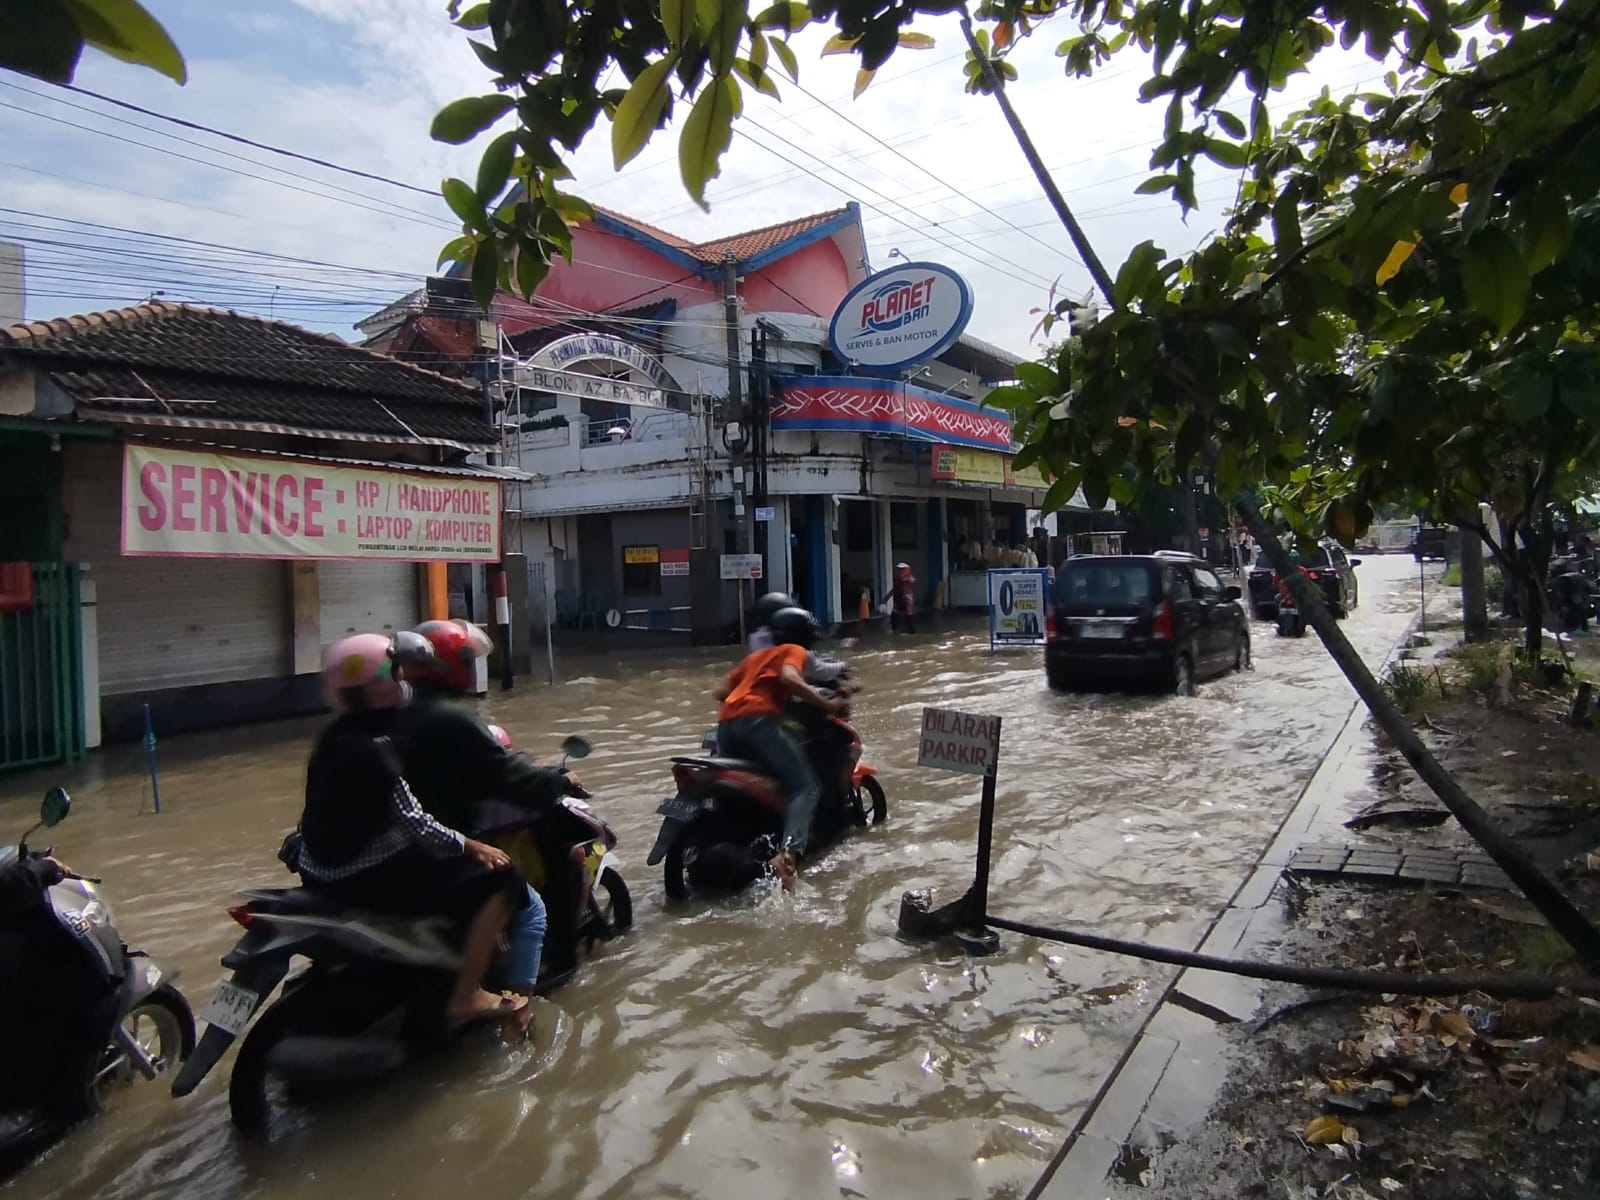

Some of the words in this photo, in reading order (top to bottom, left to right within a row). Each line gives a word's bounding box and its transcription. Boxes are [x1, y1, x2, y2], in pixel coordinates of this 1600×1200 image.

[861, 276, 936, 329] PLANET
[903, 304, 930, 326] BAN
[846, 340, 874, 351] SERVIS
[884, 335, 902, 345] BAN
[904, 329, 938, 341] MOTOR
[533, 371, 573, 391] BLOK
[138, 461, 324, 537] SERVICE
[356, 480, 380, 508] HP
[397, 483, 491, 516] HANDPHONE
[357, 515, 413, 540] LAPTOP
[425, 519, 492, 543] KOMPUTER
[922, 738, 987, 766] PARKIR
